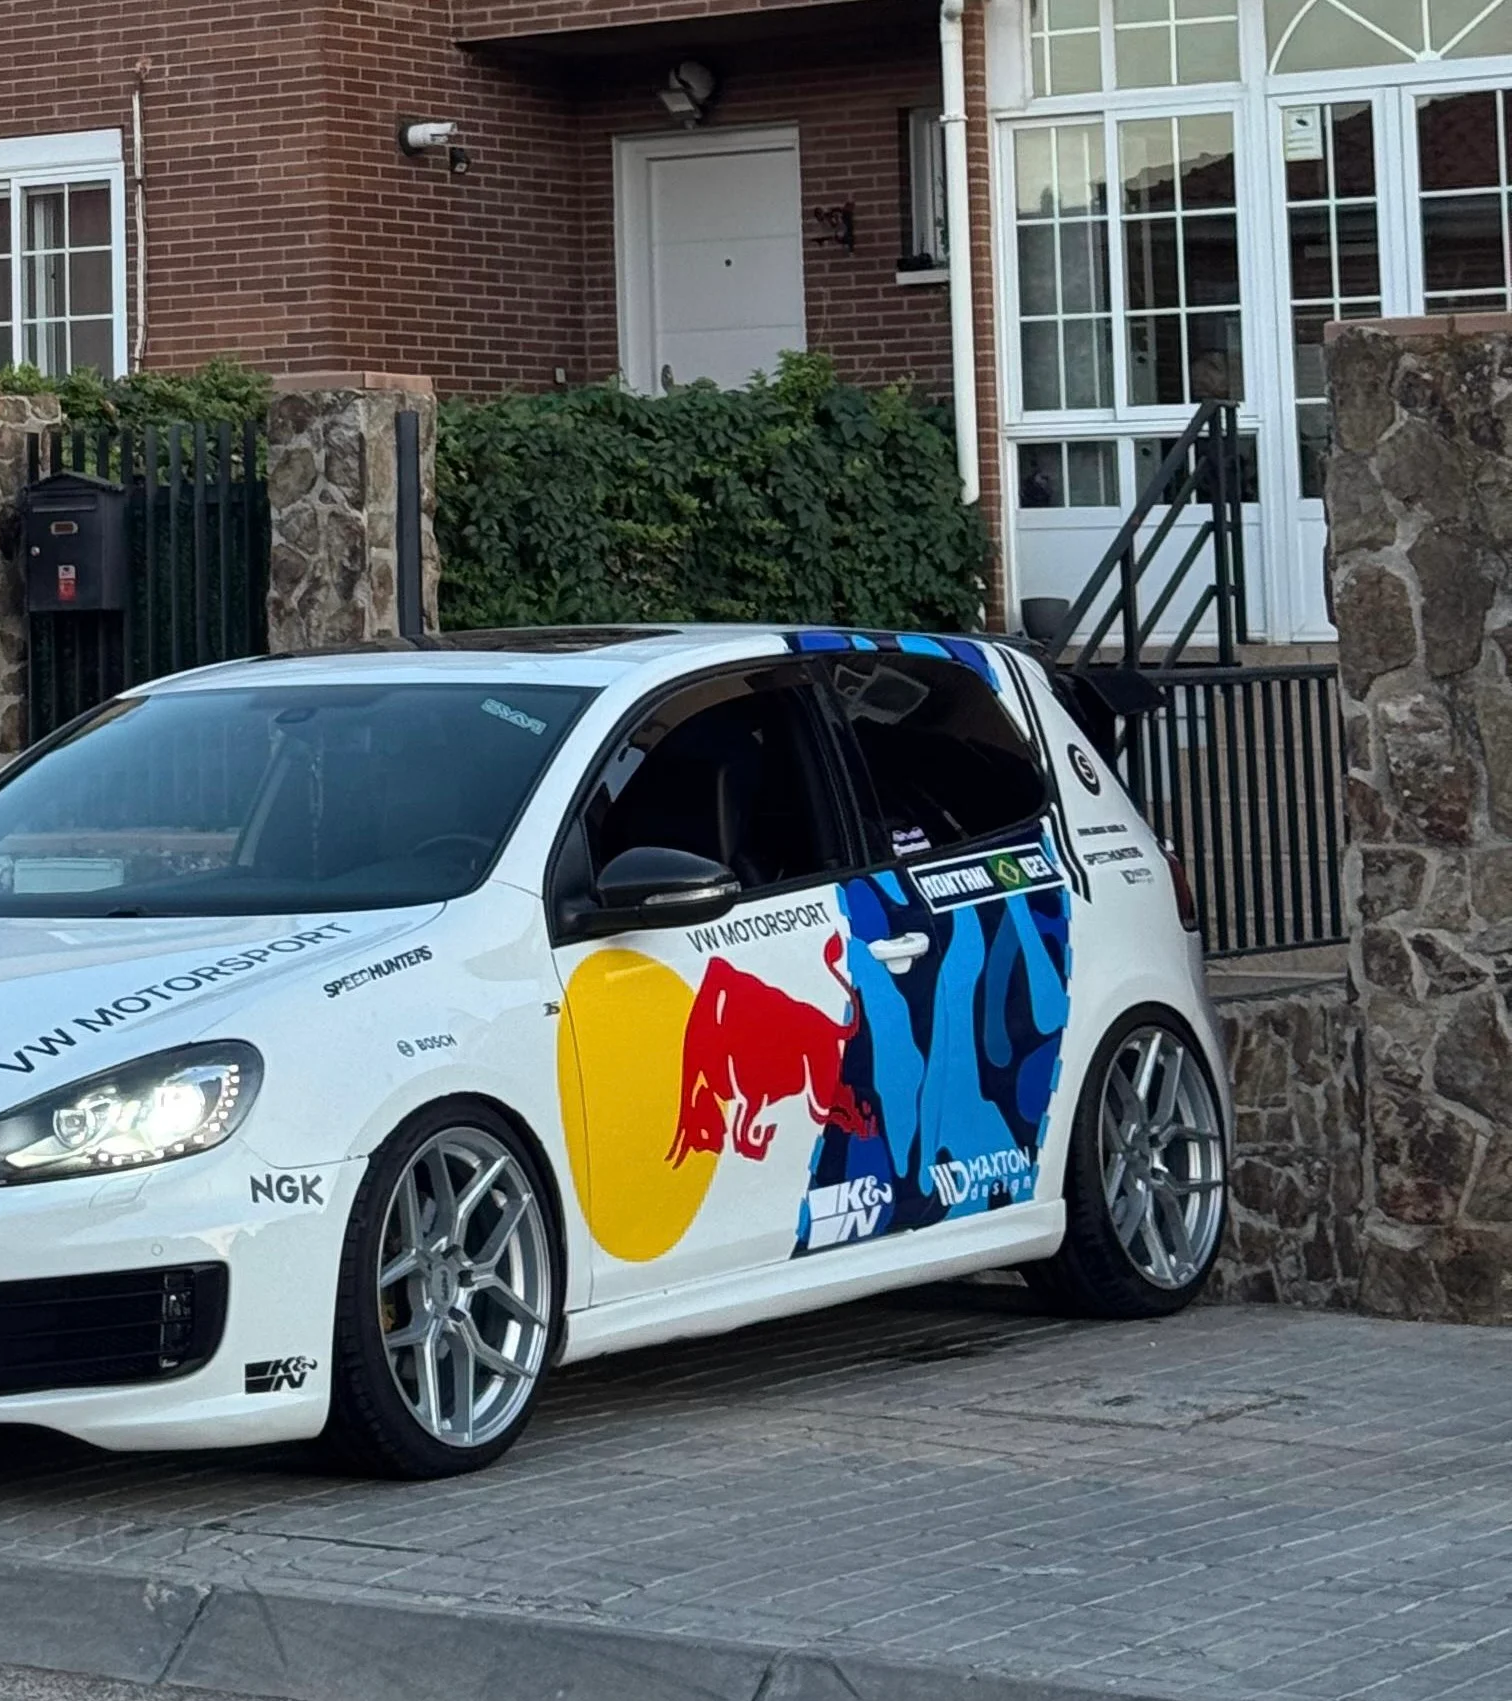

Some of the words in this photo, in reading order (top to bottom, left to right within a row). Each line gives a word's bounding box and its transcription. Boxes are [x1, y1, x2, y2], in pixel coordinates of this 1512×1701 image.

[686, 926, 720, 953] VW
[718, 902, 831, 946] MOTORSPORT
[72, 922, 352, 1033] MOTORSPORT
[323, 945, 433, 998] SPEEDHUNTERS
[415, 1033, 457, 1051] BOSCH
[969, 1146, 1031, 1182] MAXTON
[250, 1173, 324, 1206] NGK
[970, 1174, 1032, 1200] design
